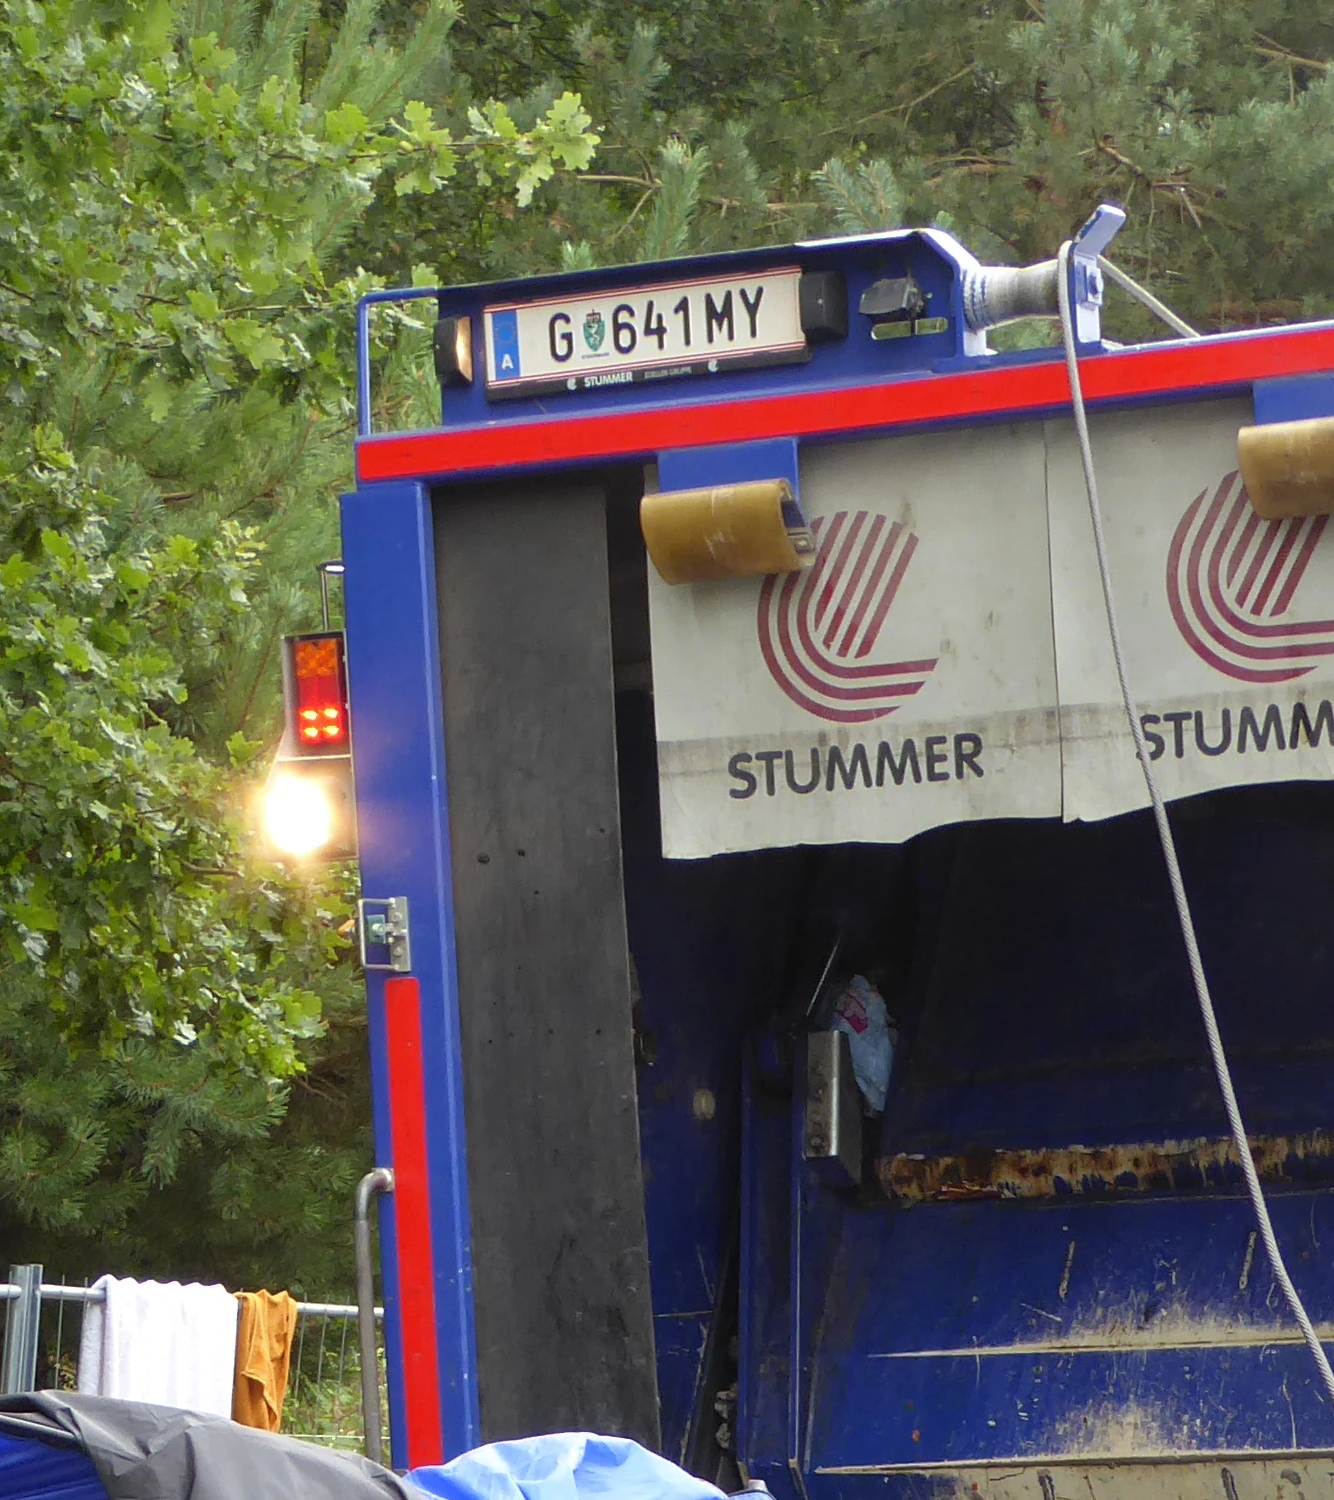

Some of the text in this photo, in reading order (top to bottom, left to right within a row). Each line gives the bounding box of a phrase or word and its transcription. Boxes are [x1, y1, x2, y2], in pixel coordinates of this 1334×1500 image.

[548, 312, 574, 363] G
[501, 353, 514, 370] A
[583, 371, 634, 388] STUMMER
[728, 732, 985, 800] STUMMER
